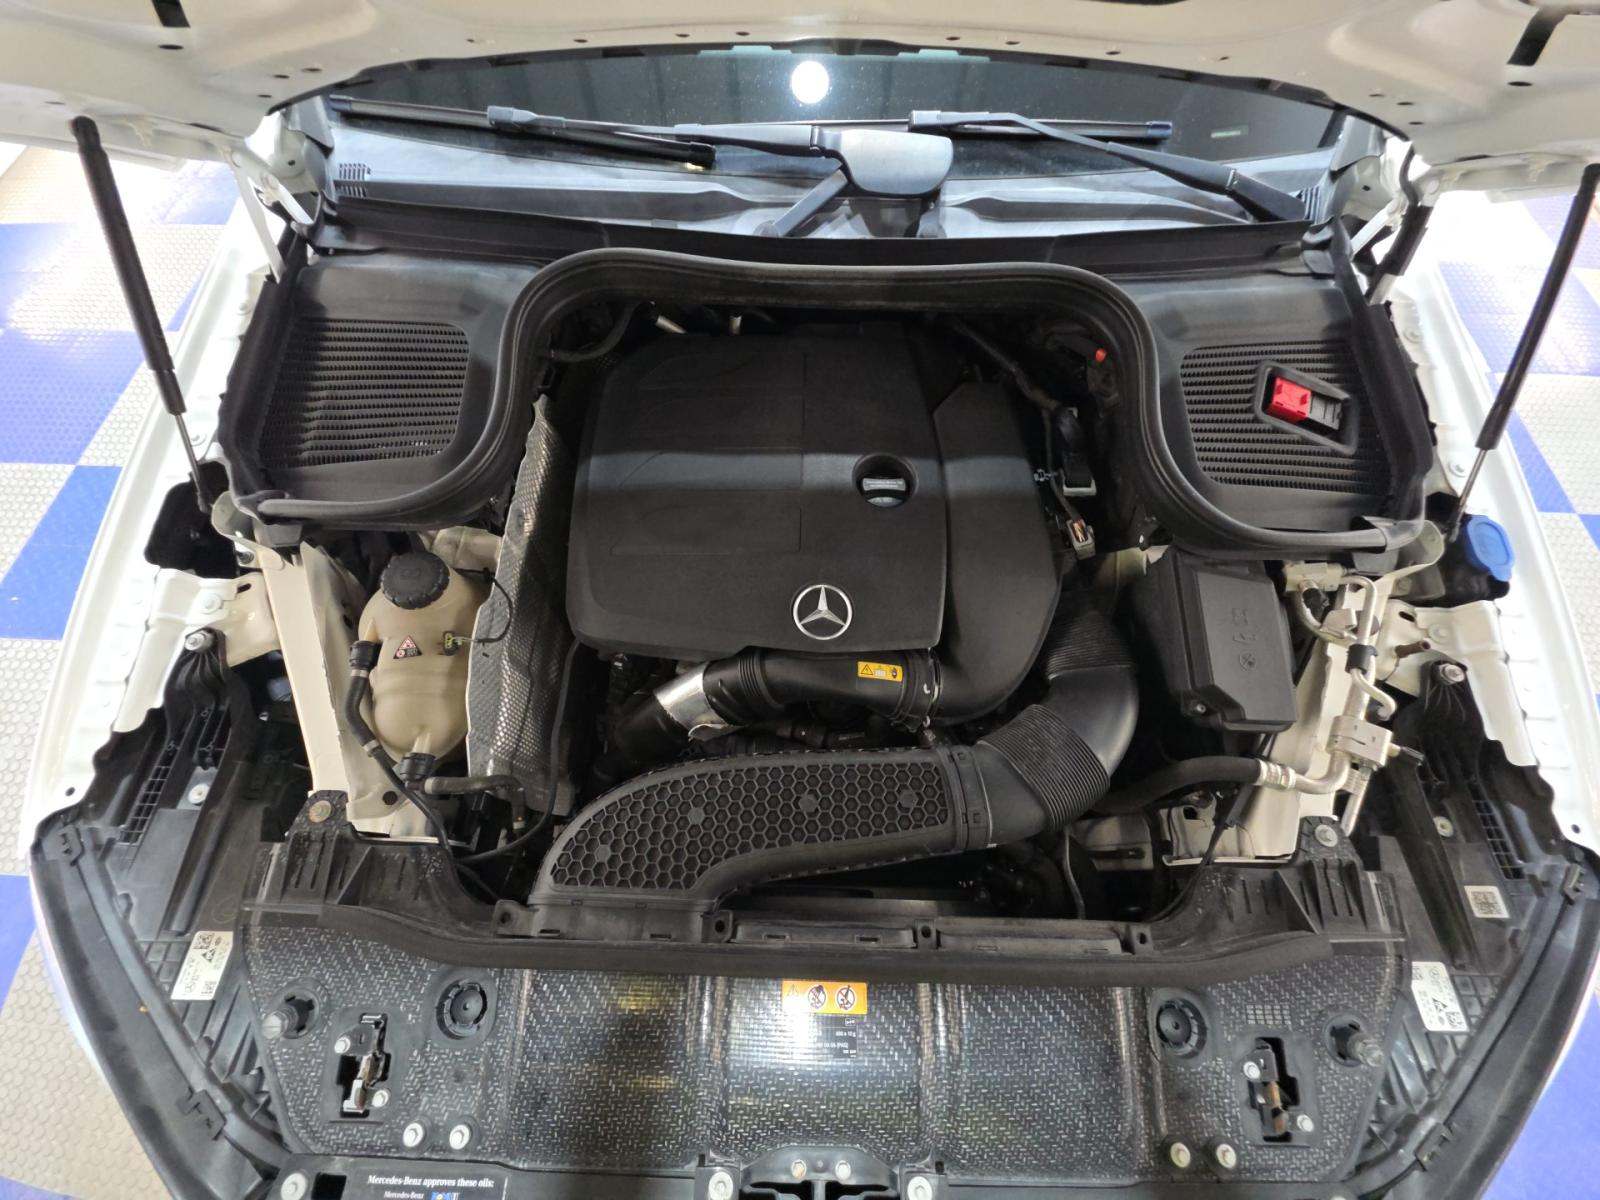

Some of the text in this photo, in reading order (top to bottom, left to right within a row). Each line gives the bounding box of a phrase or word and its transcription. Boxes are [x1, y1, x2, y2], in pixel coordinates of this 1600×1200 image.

[367, 1175, 495, 1188] Mercedes-Benz approves these oils:
[384, 1190, 424, 1199] Mercedes-Benz
